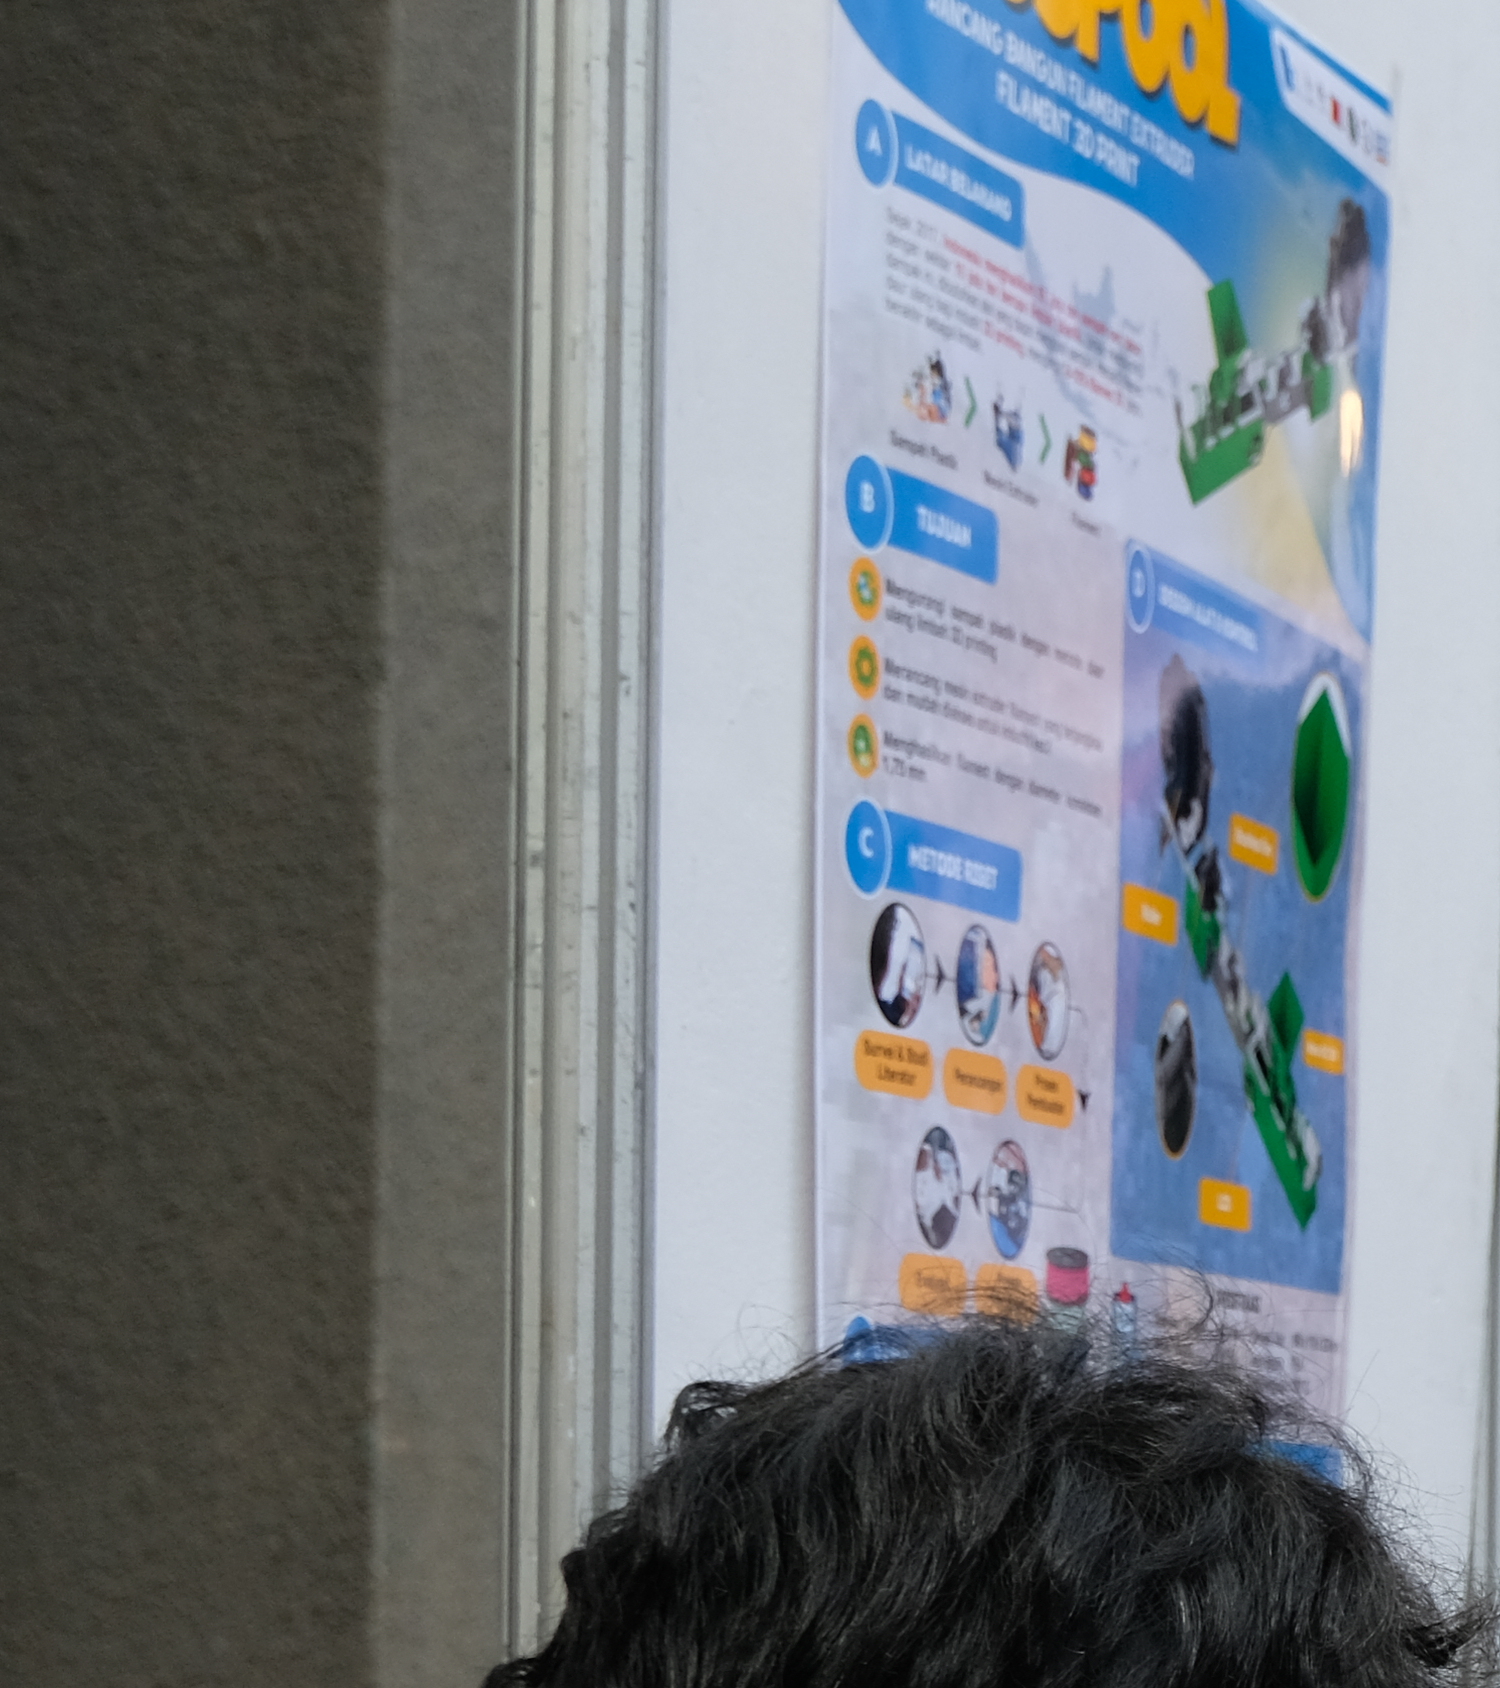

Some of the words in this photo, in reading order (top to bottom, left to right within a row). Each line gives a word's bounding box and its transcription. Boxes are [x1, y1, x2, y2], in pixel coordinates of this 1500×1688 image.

[1068, 69, 1130, 137] FILAMENT
[865, 123, 883, 158] A
[995, 68, 1073, 146] FILAMENT
[1094, 130, 1141, 188] PRINT
[859, 479, 876, 514] B
[915, 502, 973, 549] TUJUAN
[858, 825, 875, 858] C
